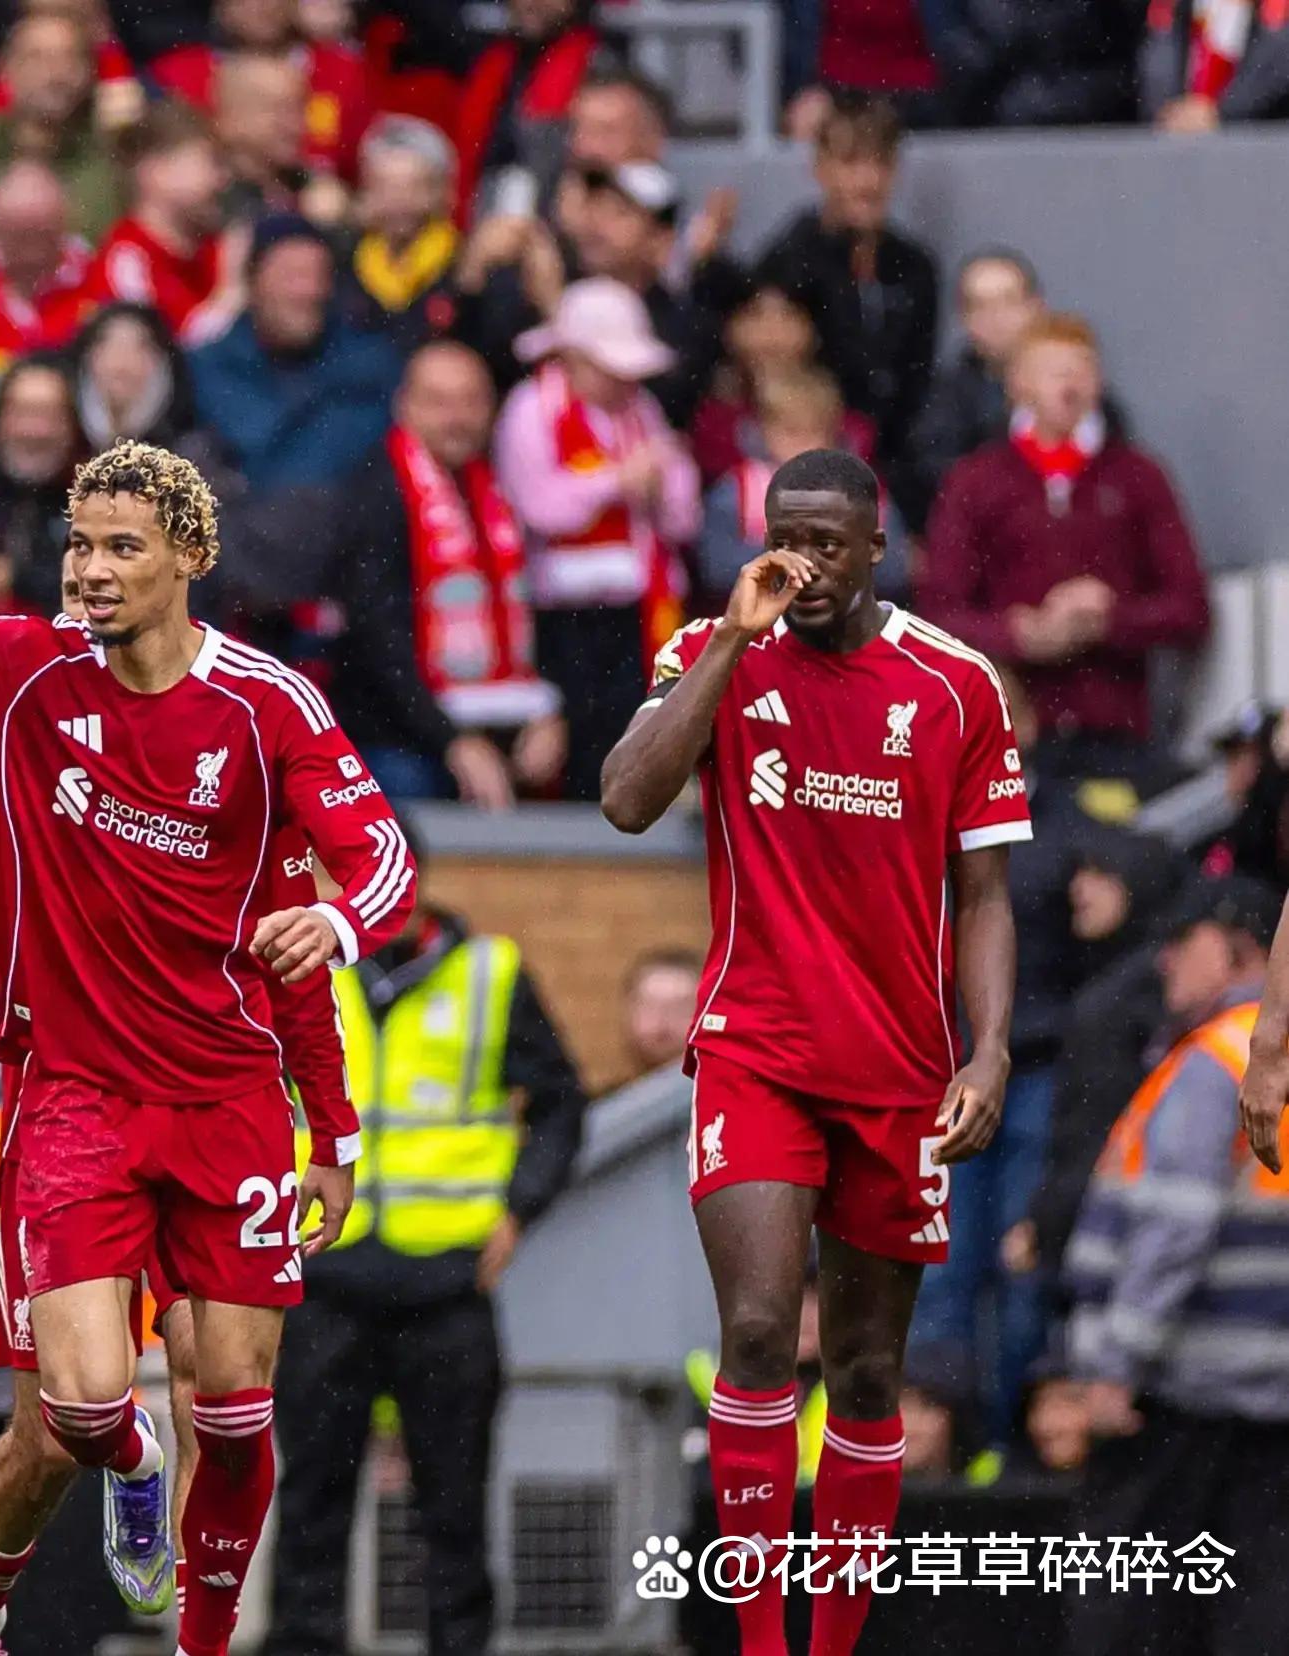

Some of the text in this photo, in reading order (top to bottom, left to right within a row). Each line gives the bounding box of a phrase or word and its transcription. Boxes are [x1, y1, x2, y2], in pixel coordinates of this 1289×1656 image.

[99, 794, 208, 839] standard
[794, 785, 903, 820] chartered
[94, 812, 210, 859] chartered
[919, 1135, 950, 1207] 5
[237, 1171, 301, 1248] 22
[723, 1482, 774, 1505] LFC
[201, 1531, 248, 1551] LFC
